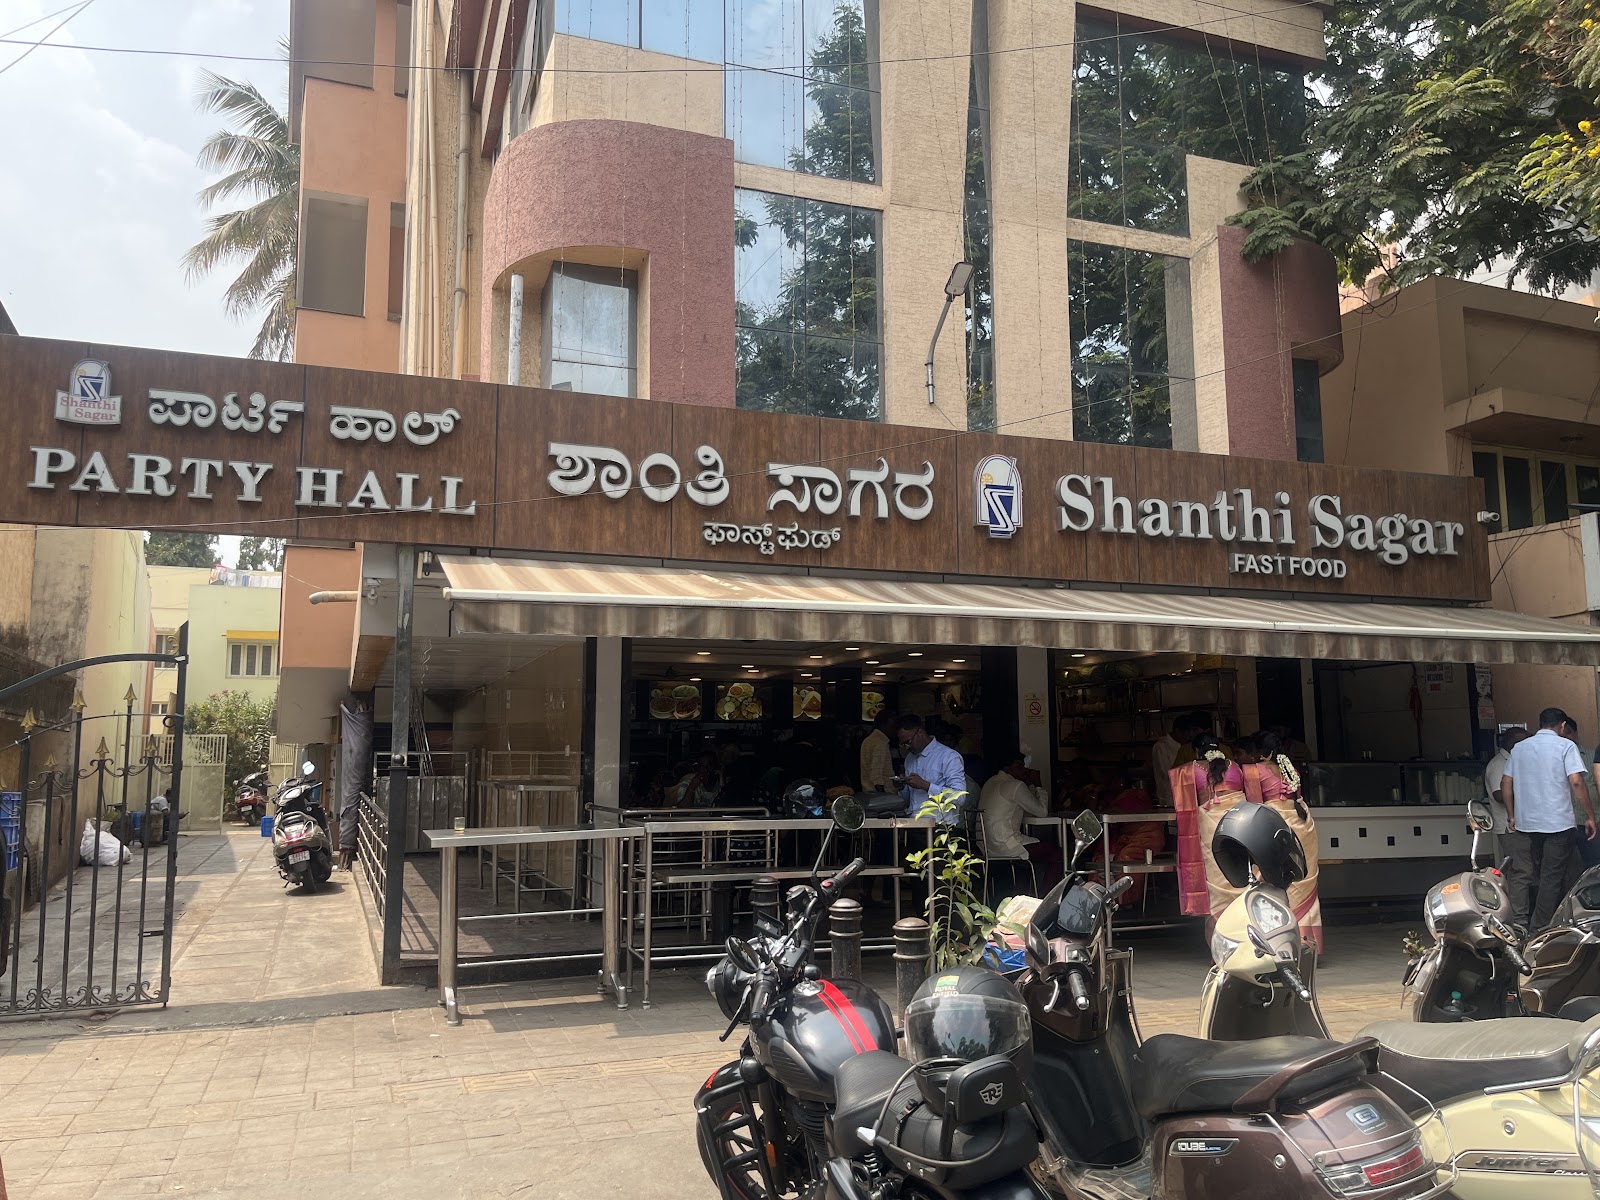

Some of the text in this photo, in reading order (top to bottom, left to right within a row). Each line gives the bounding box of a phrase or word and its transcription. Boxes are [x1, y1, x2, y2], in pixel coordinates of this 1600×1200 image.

[60, 396, 117, 410] Shanthi
[74, 407, 116, 421] Sagar
[329, 405, 461, 446] ಹಾಲ್
[26, 446, 478, 516] PARTY HALL
[547, 441, 935, 521] ಶಾಂತಿ ಸಾಗರ
[1056, 473, 1466, 567] Shanthi Sagar
[1230, 553, 1347, 578] FAST FOOD
[1475, 1156, 1568, 1167] Jupiter
